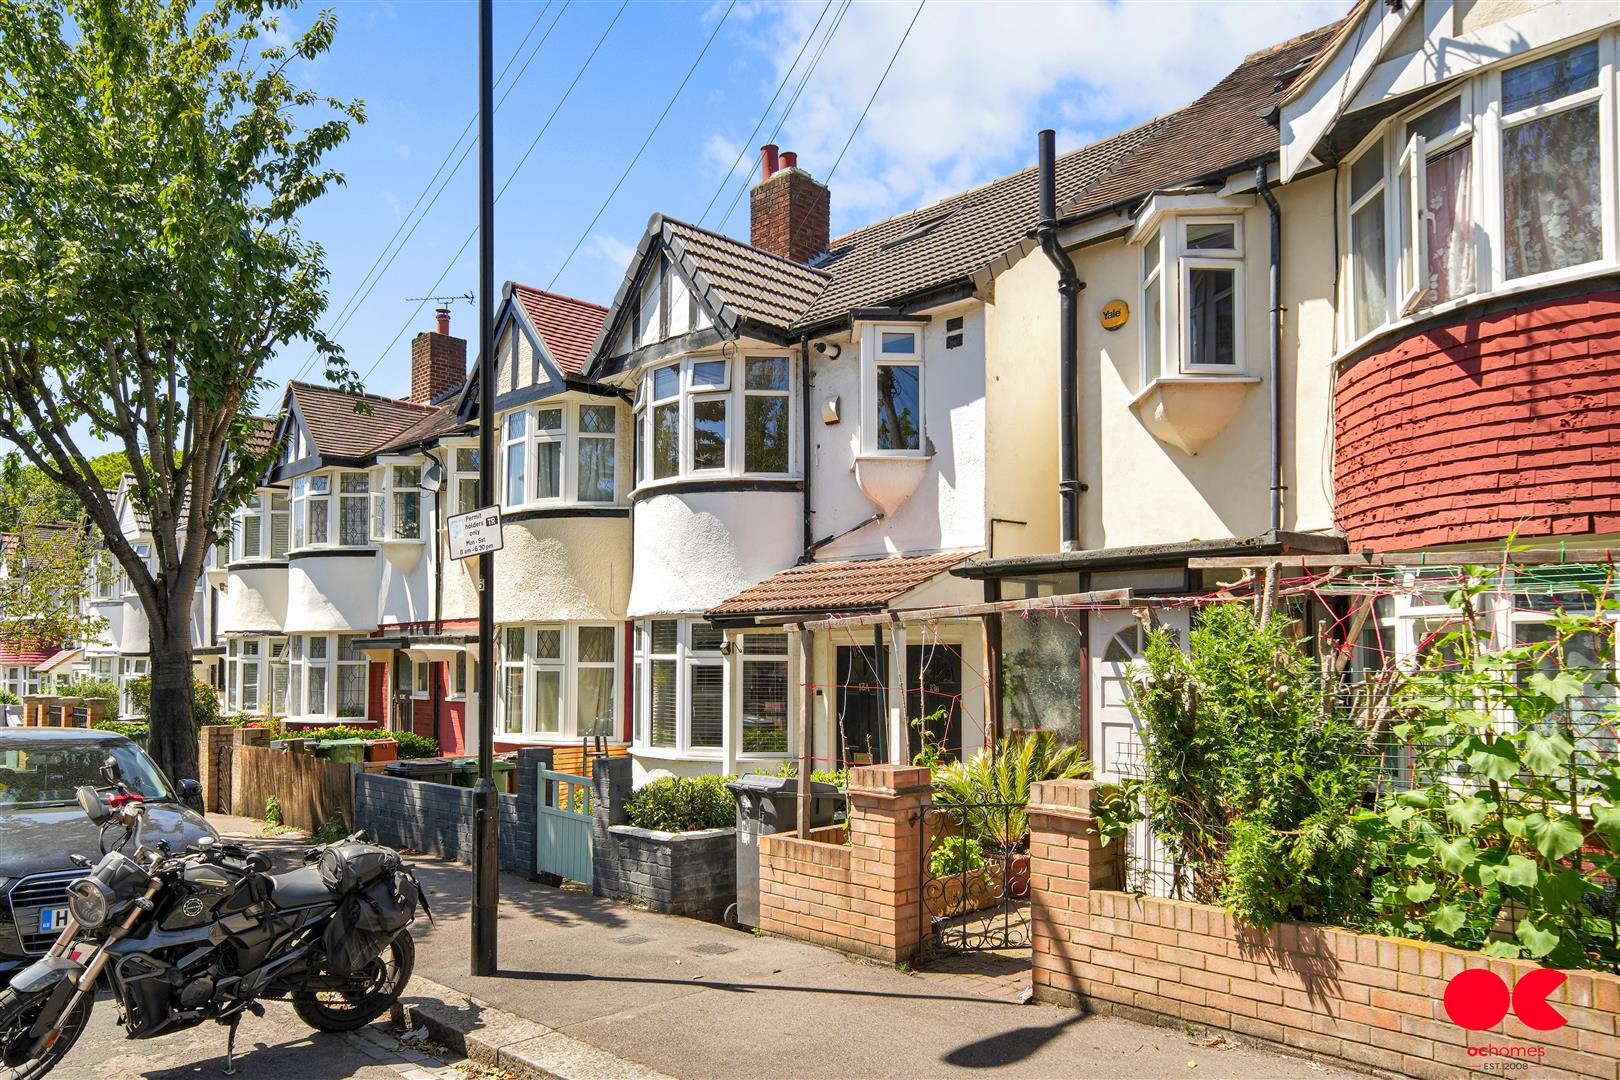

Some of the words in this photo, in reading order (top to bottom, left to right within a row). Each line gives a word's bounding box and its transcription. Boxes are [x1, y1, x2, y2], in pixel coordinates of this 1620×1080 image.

[1102, 309, 1121, 320] Yale
[465, 513, 482, 522] Permit
[487, 516, 497, 525] TR
[464, 521, 484, 530] holders
[469, 529, 481, 537] only
